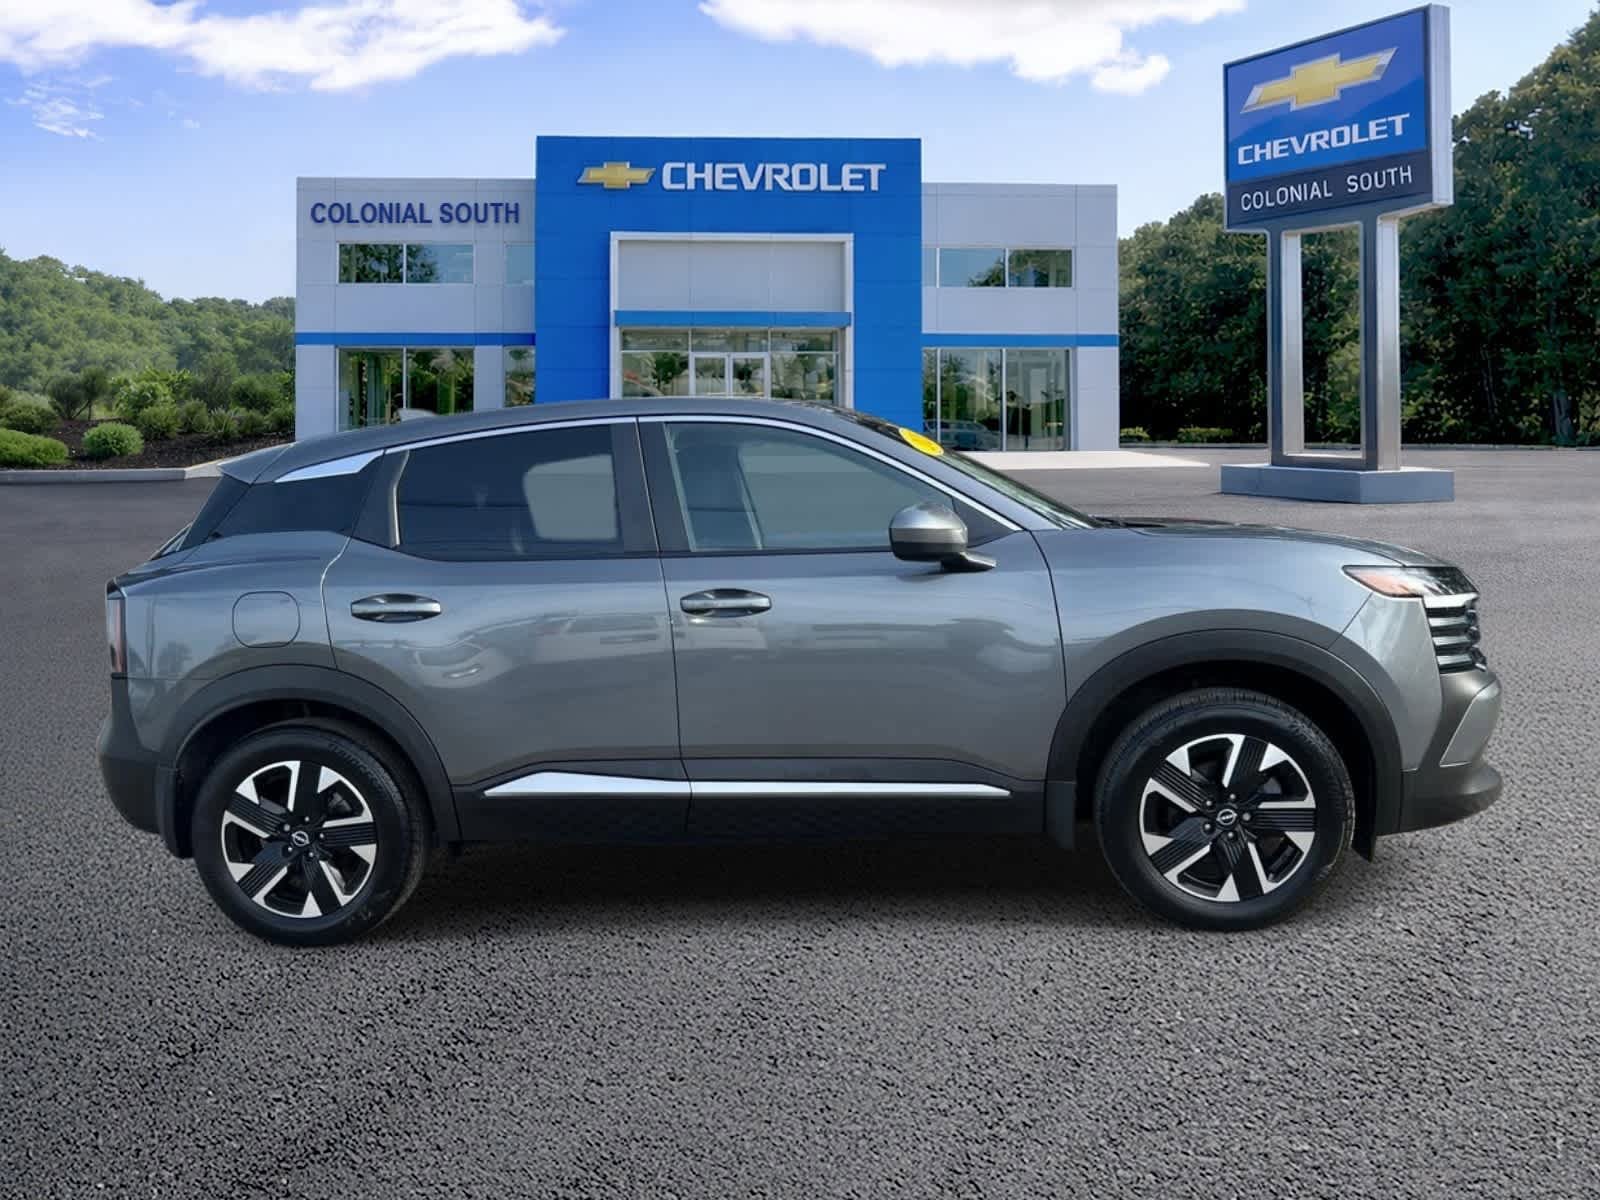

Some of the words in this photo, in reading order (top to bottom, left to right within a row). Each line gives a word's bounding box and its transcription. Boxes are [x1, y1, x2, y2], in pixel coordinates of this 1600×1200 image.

[1238, 113, 1410, 165] CHEVROLET
[662, 162, 887, 191] CHEVROLET
[1241, 180, 1333, 211] COLONIAL
[1346, 165, 1412, 193] SOUTH
[310, 202, 432, 224] COLONIAL
[439, 202, 520, 224] SOUTH
